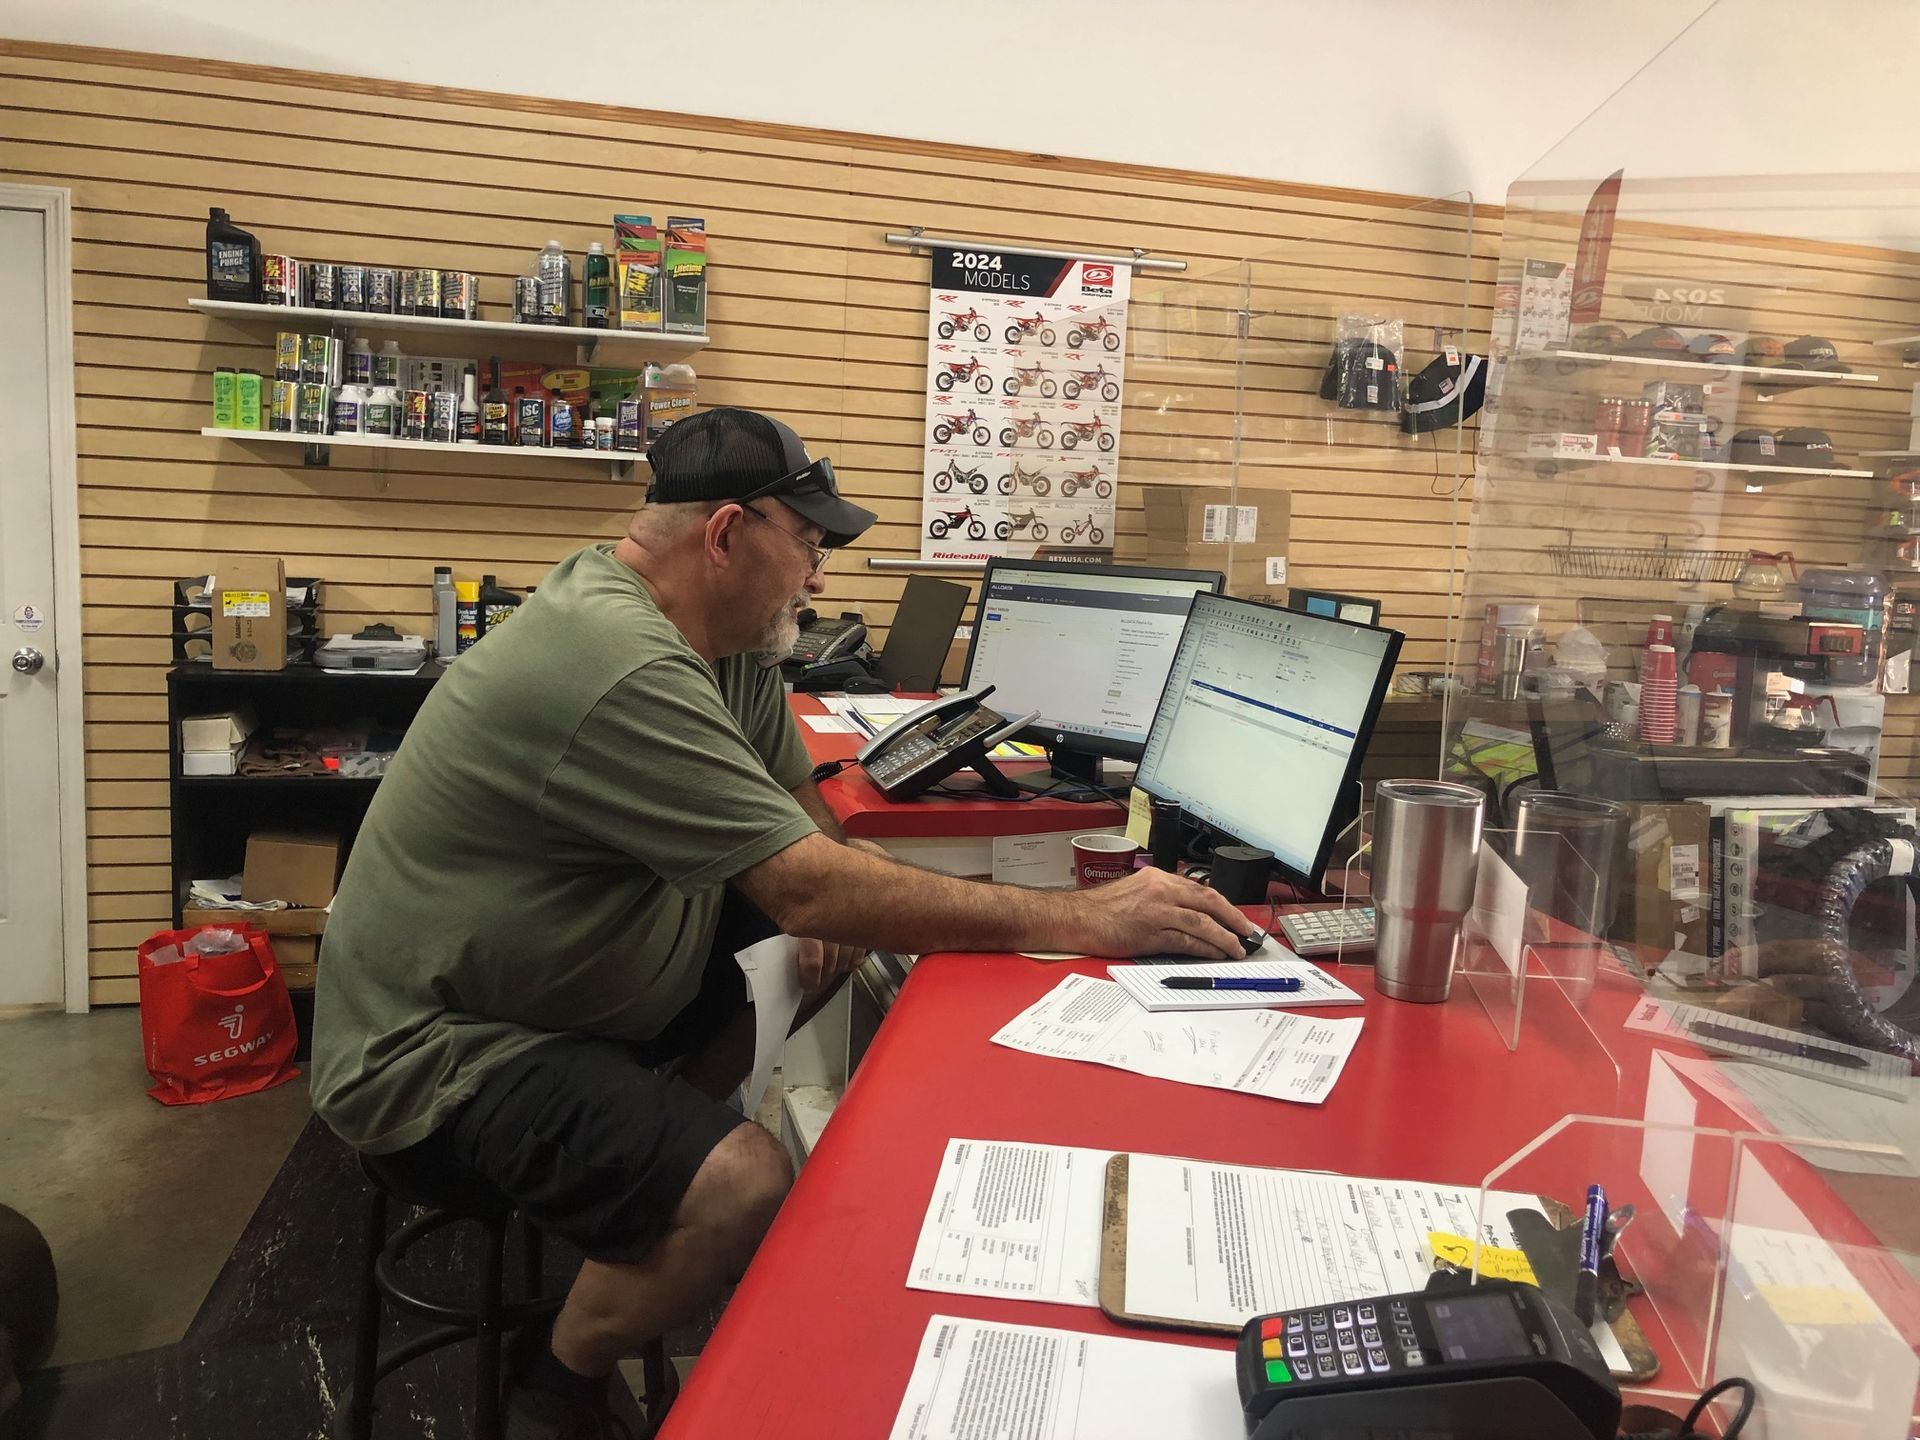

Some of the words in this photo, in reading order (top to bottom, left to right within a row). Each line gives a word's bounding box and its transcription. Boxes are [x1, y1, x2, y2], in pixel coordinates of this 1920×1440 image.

[219, 249, 243, 259] ENGINE
[220, 258, 243, 267] PURGE
[951, 252, 1002, 271] 2024
[964, 271, 1031, 291] MODELS
[1081, 286, 1113, 294] Beta
[522, 403, 539, 417] ISC
[650, 401, 670, 411] Power
[671, 398, 690, 409] Clean
[1048, 555, 1102, 563] BETAUSA.COM
[194, 1031, 274, 1067] SEGWAY
